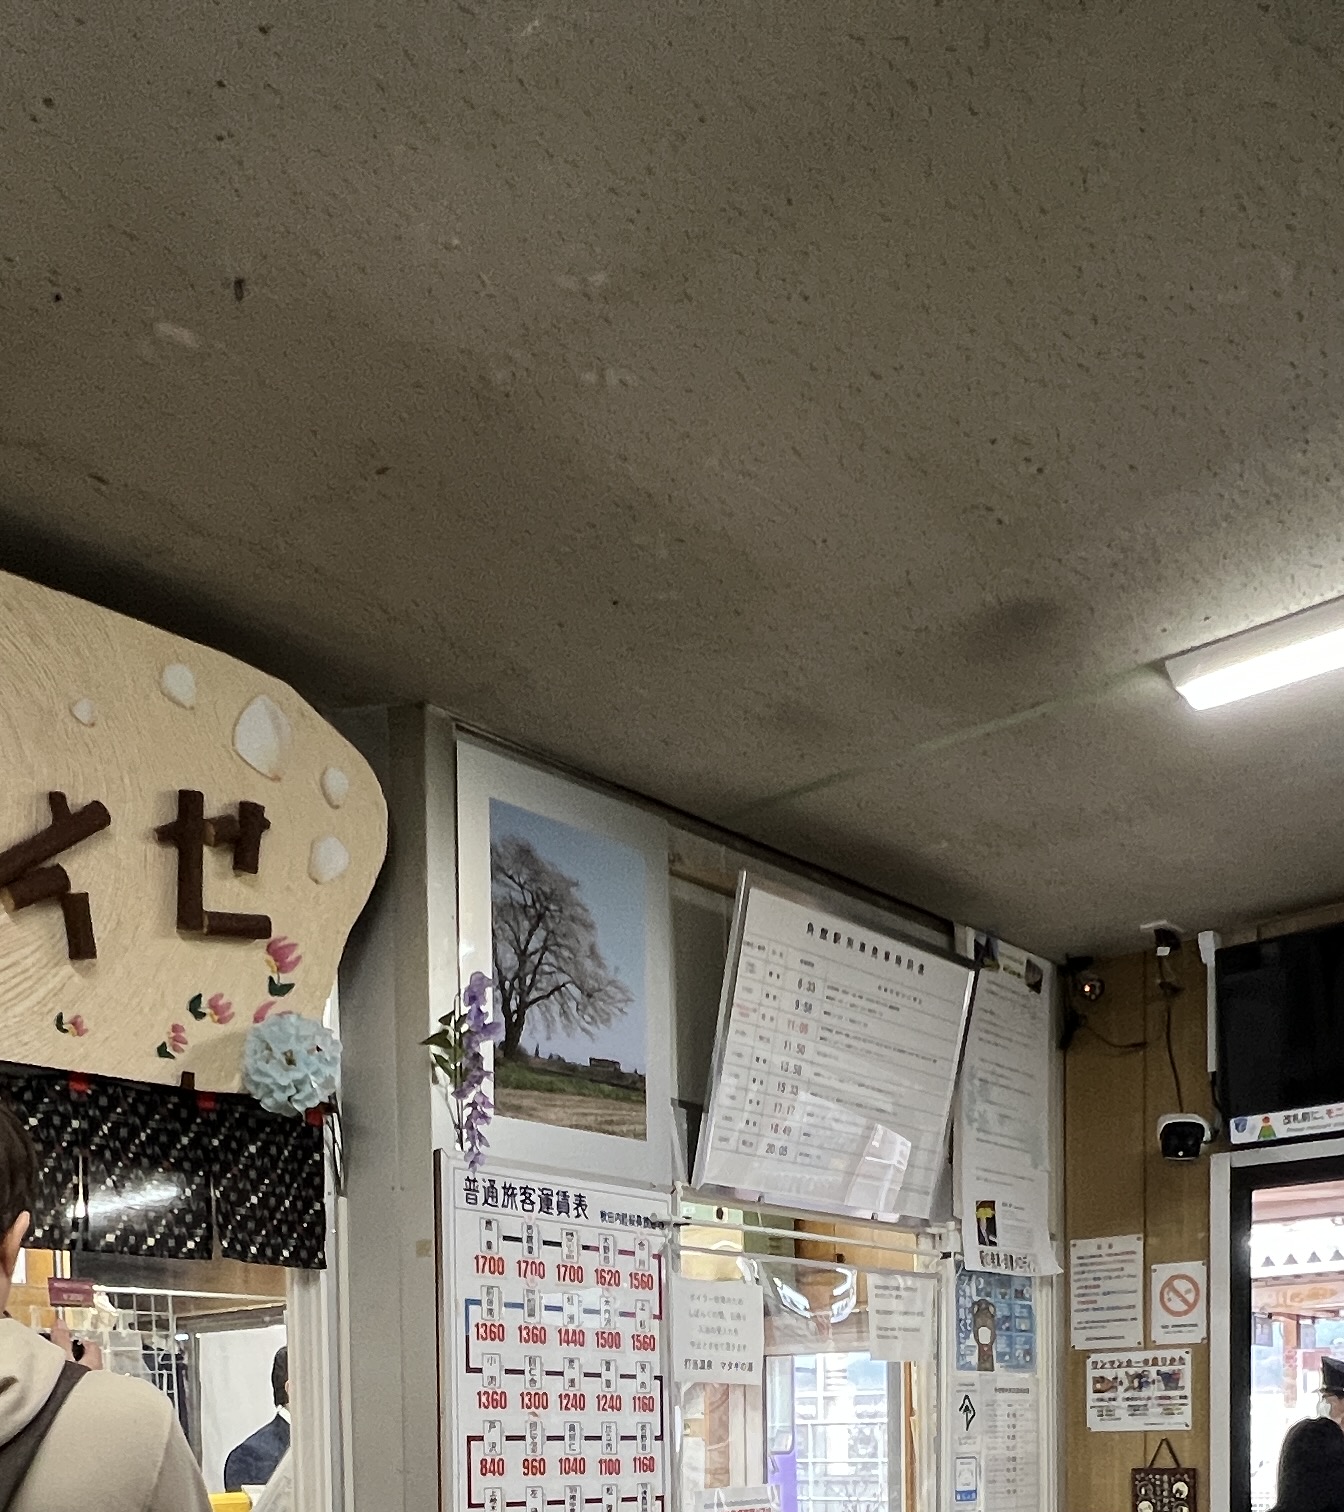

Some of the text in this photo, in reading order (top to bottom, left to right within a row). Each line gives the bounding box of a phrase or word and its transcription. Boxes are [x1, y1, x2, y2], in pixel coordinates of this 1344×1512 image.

[463, 1176, 589, 1220] 普通旅客運賃表
[474, 1255, 505, 1275] 1700
[516, 1260, 546, 1279] 1700
[556, 1264, 583, 1283] 1700
[594, 1268, 621, 1287] 1620
[629, 1272, 653, 1290] 1560
[475, 1323, 505, 1342] 1360
[518, 1326, 547, 1345] 1360
[558, 1329, 585, 1347] 1440
[595, 1332, 621, 1349] 1500
[631, 1334, 656, 1351] 1560
[477, 1391, 507, 1410] 1360
[520, 1392, 549, 1410] 1300
[558, 1393, 586, 1411] 1240
[596, 1394, 622, 1412] 1240
[633, 1396, 655, 1412] 1160
[480, 1458, 505, 1476] 840
[523, 1458, 546, 1476] 960
[559, 1458, 586, 1475] 1040
[598, 1459, 621, 1476] 1100
[633, 1456, 655, 1473] 1160
